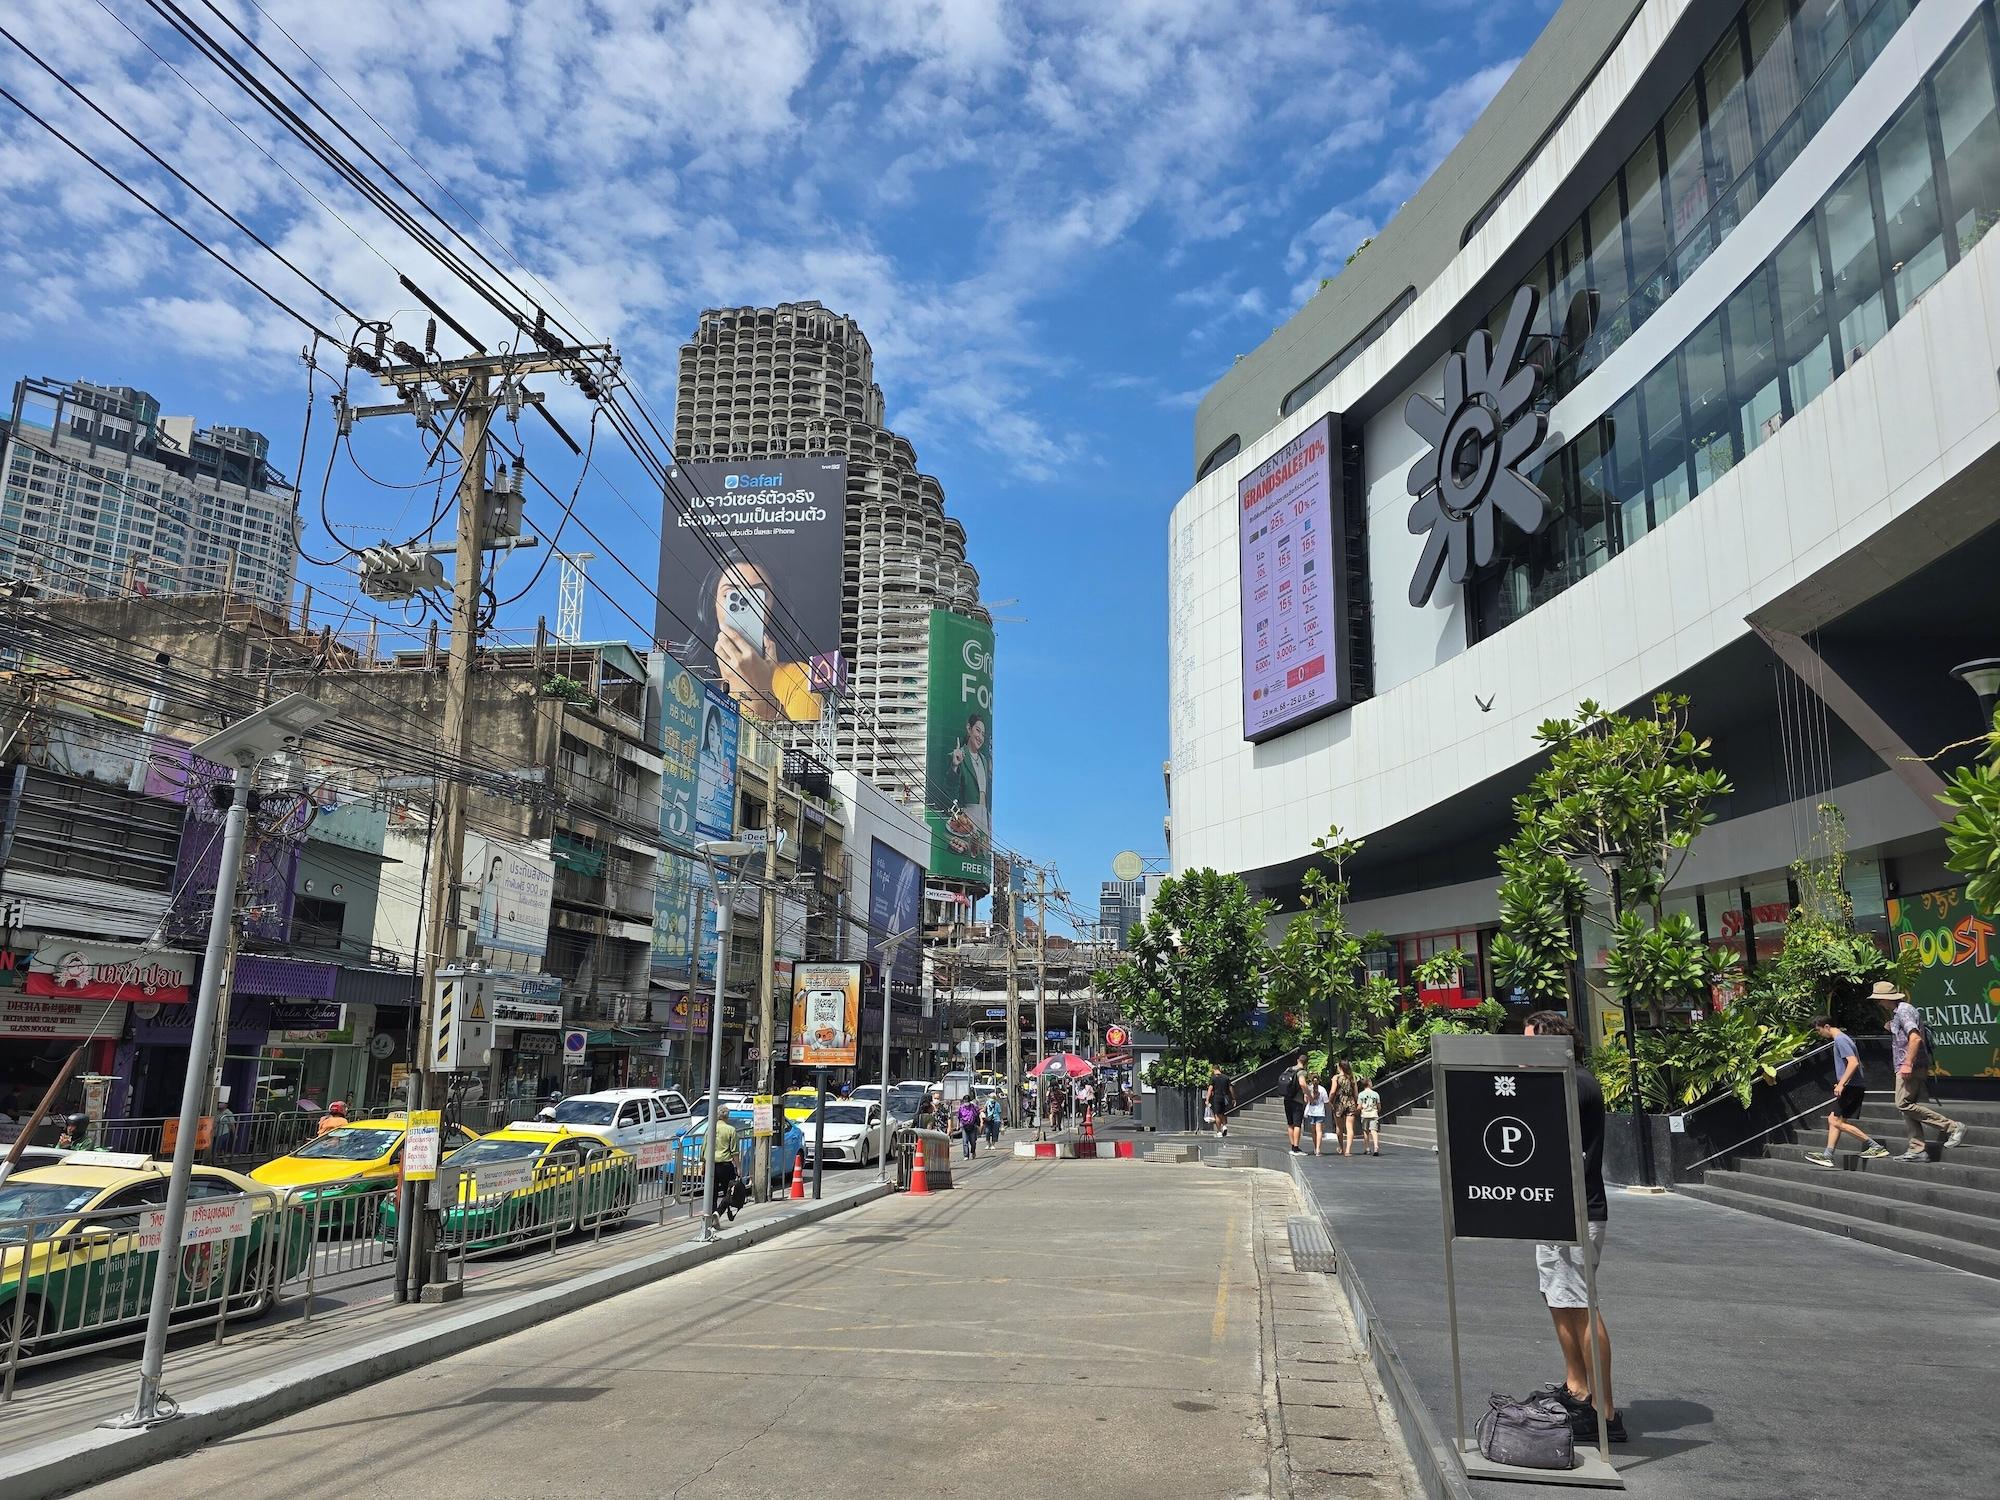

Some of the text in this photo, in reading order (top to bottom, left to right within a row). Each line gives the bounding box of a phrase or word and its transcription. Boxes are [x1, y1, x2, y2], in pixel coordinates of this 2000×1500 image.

[1259, 439, 1306, 478] CENTRAL
[1304, 436, 1325, 468] 70%
[739, 473, 783, 488] Safari
[773, 527, 796, 536] iPhone
[669, 789, 690, 837] 5
[961, 862, 982, 875] FREE
[1944, 979, 1957, 996] X
[303, 1003, 337, 1019] Kitchen
[1501, 1126, 1522, 1153] P
[1468, 1185, 1554, 1202] DROP OFF
